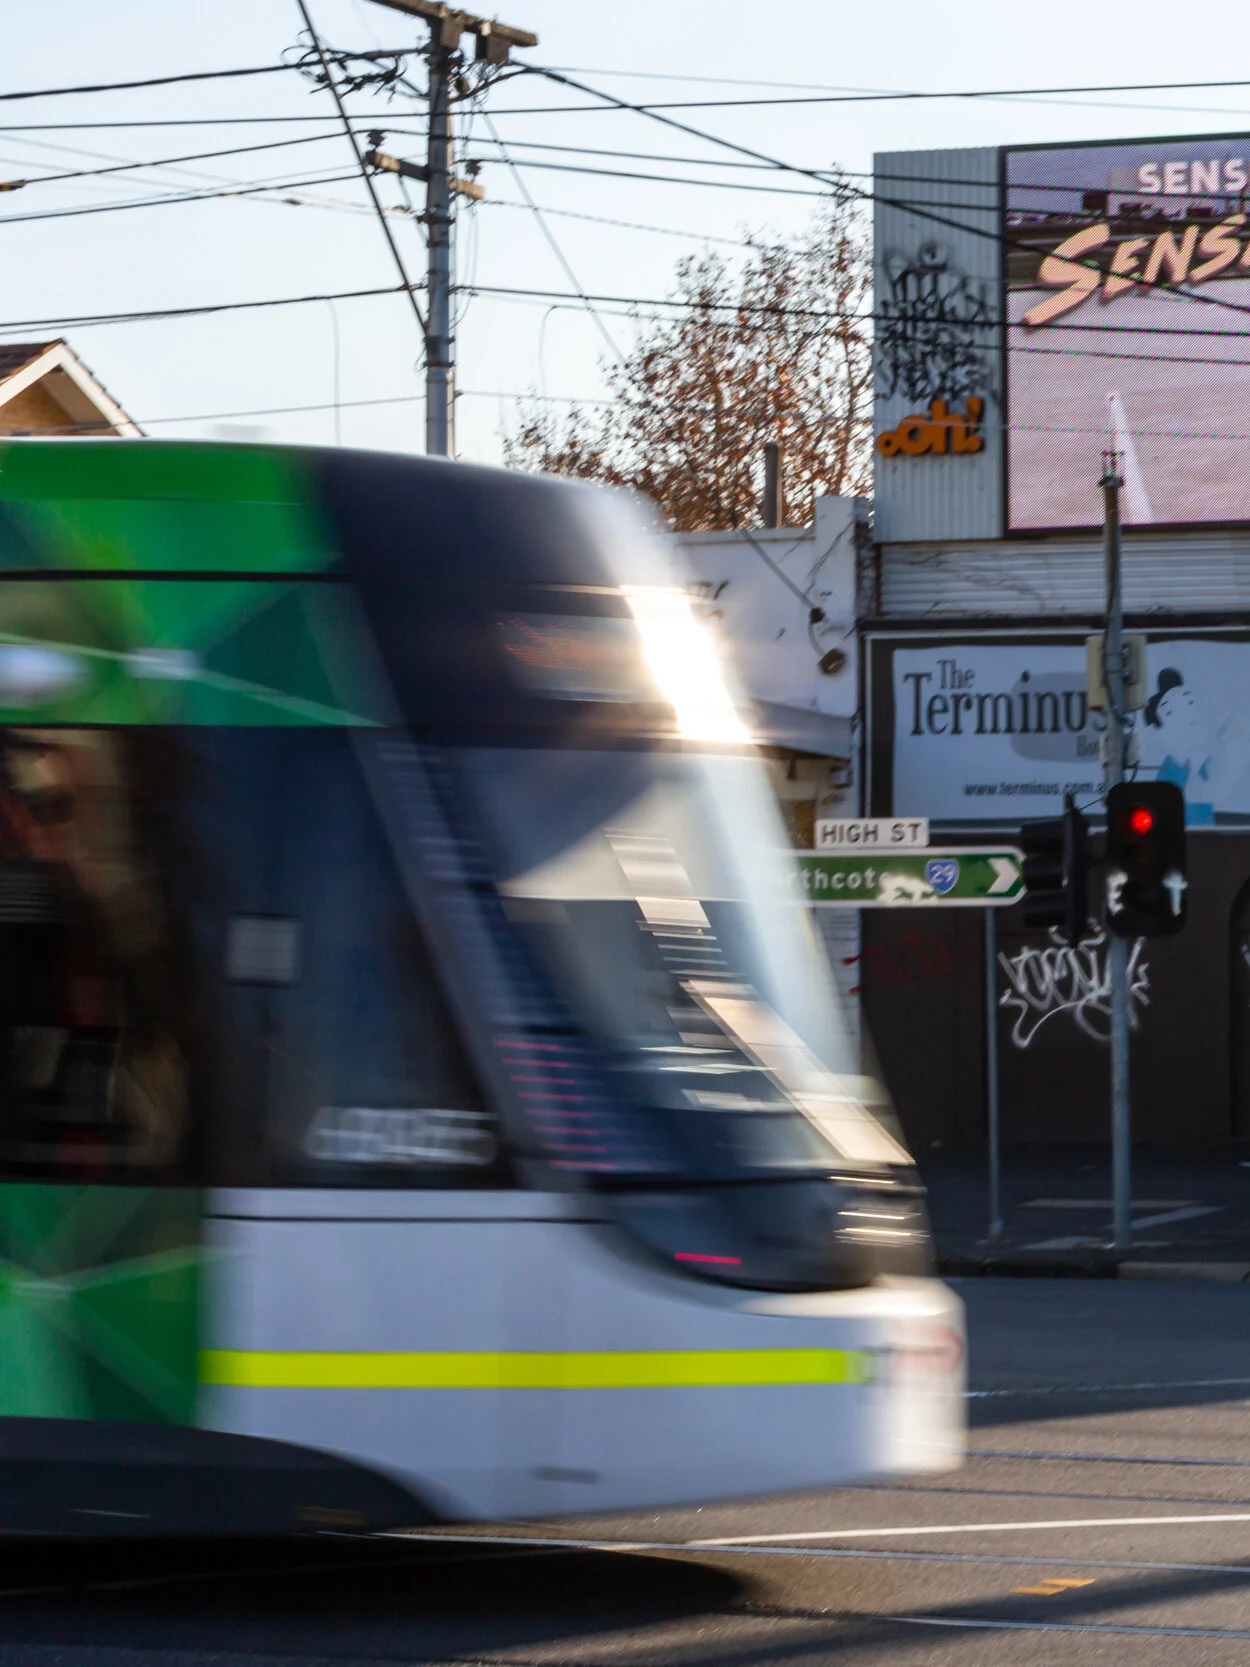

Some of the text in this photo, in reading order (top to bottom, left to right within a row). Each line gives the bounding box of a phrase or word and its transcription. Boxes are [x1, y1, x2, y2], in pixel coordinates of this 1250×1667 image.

[937, 659, 976, 690] The
[820, 822, 923, 844] HIGH ST
[929, 863, 956, 885] 29
